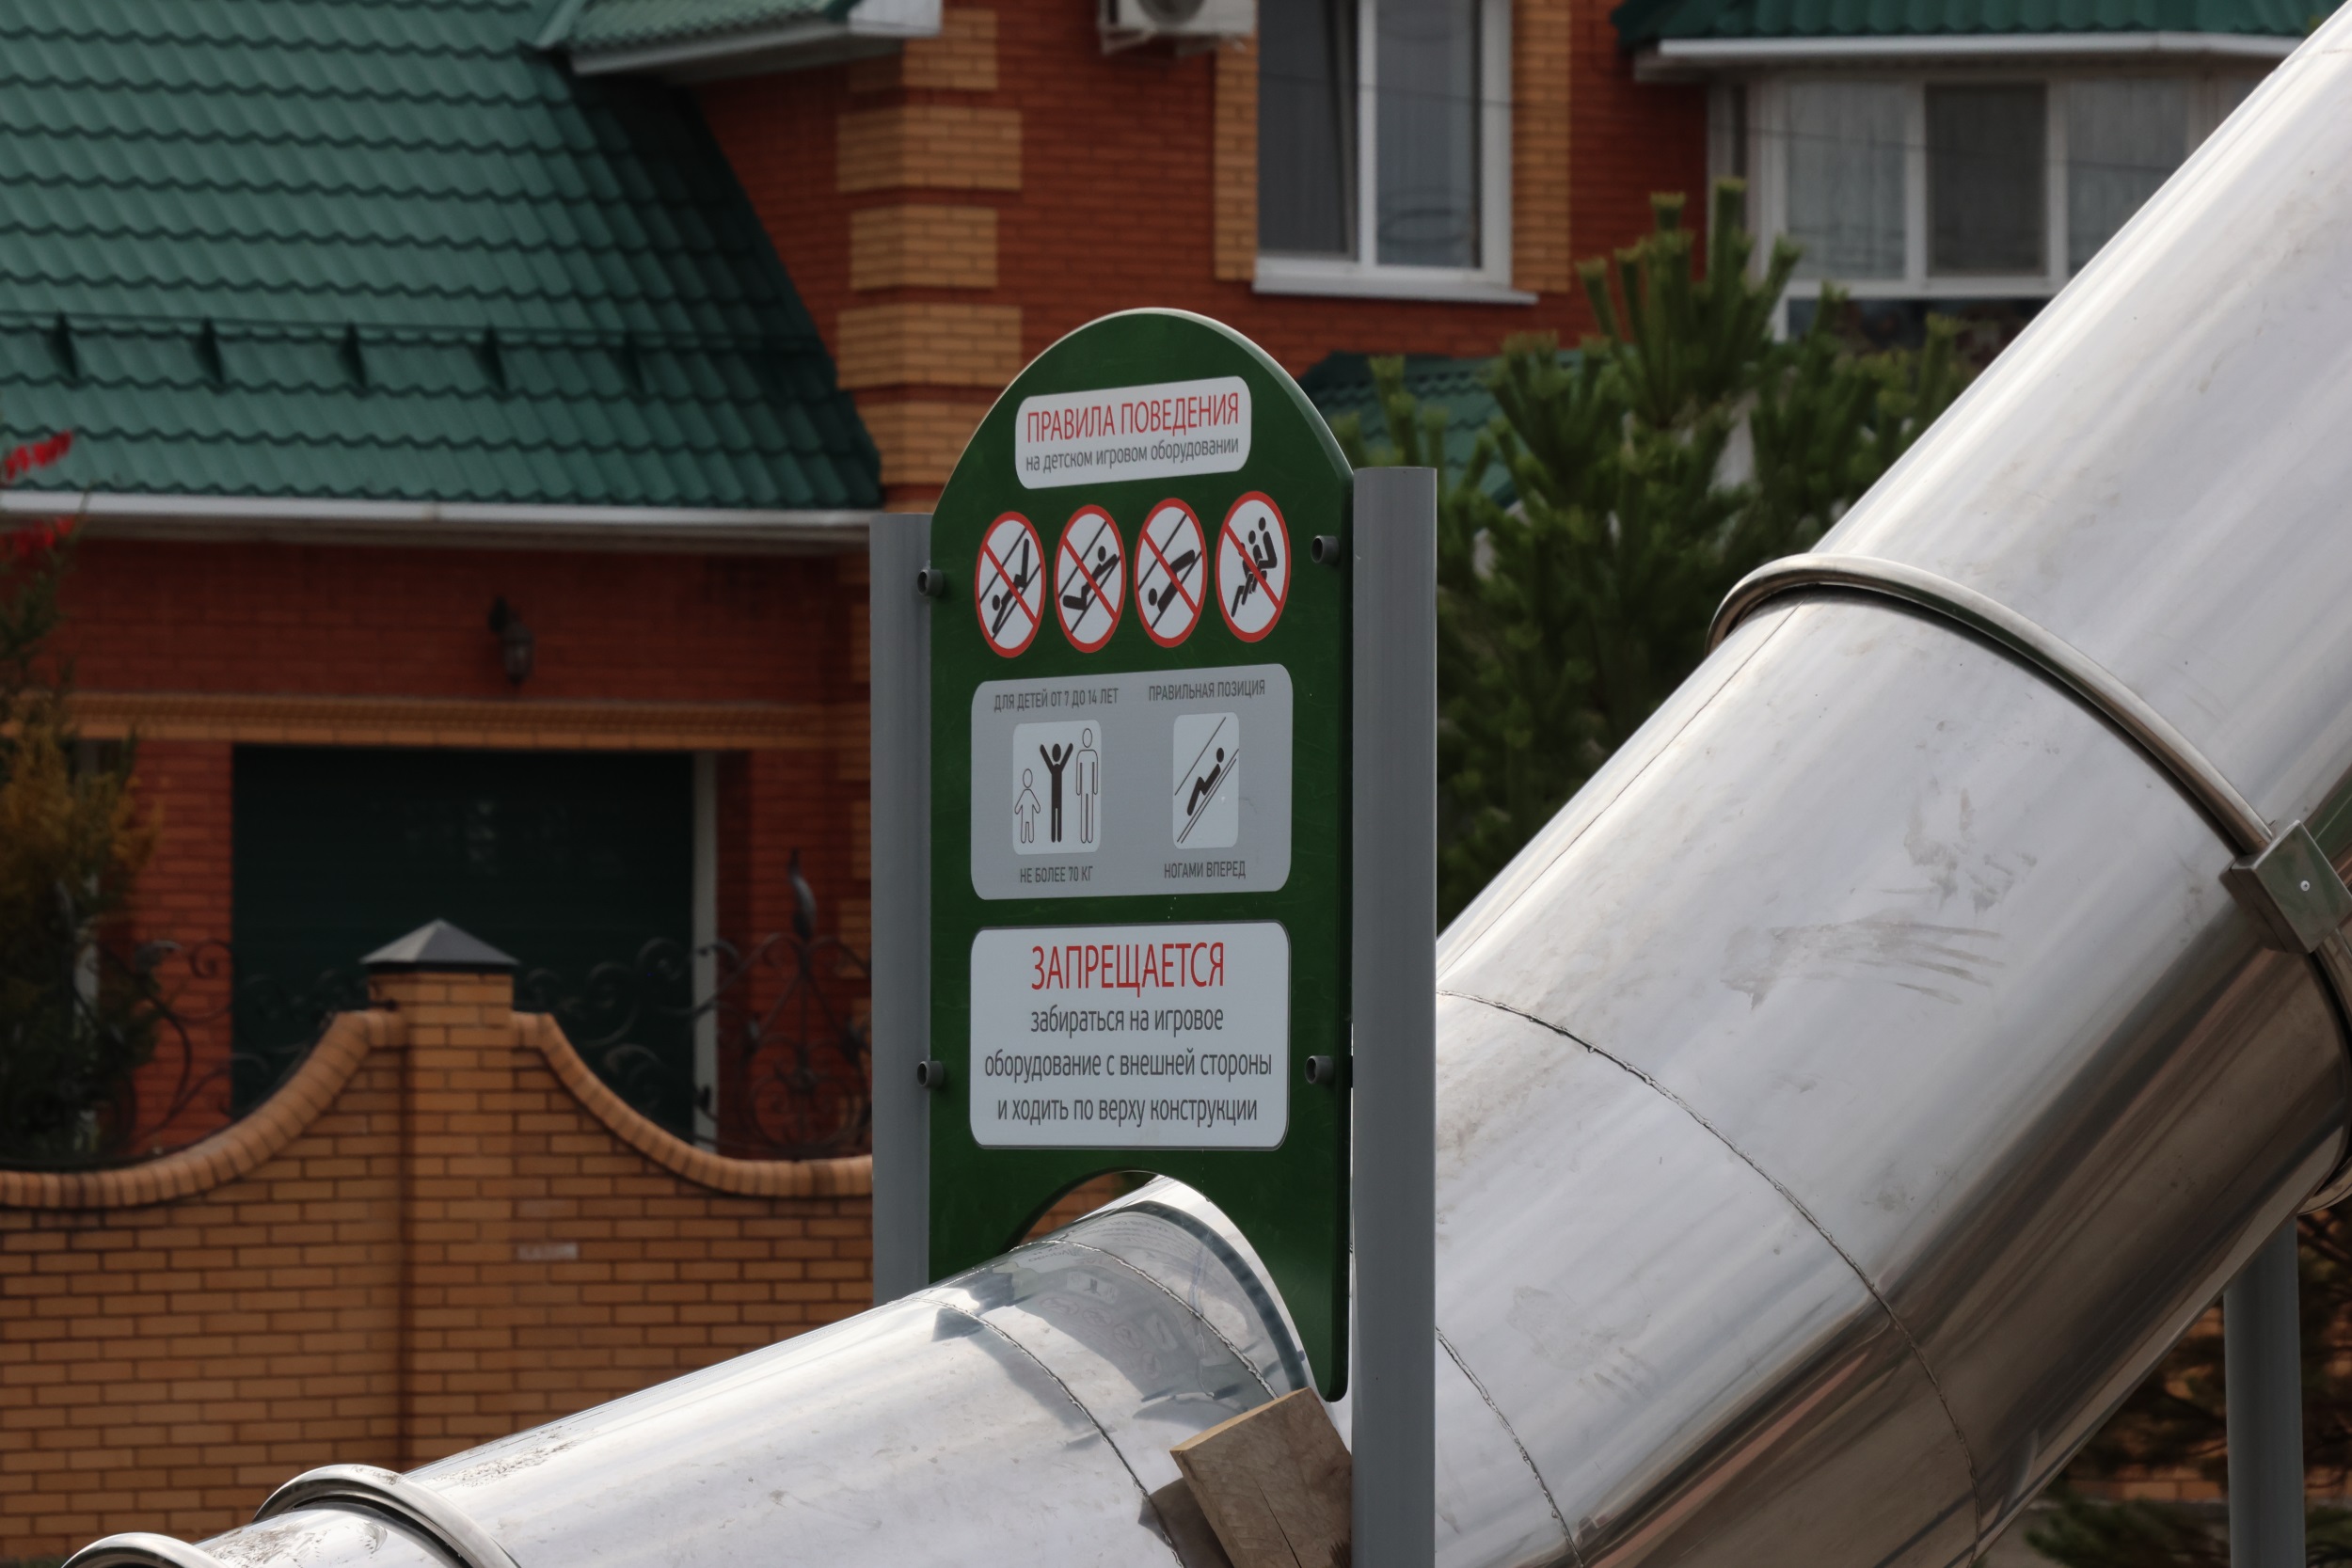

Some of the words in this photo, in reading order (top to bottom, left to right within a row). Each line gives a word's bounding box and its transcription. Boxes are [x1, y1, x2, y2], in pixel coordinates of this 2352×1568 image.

[1027, 405, 1115, 443] ПРАВИЛА
[1120, 392, 1239, 436] ПОВЕДЕНИЯ
[1025, 454, 1041, 471] на
[1042, 451, 1093, 473] детском
[1096, 447, 1148, 468] игровом
[1151, 437, 1239, 465] оборудовании
[993, 694, 1015, 713] ДЛЯ
[1017, 689, 1048, 711] ДЕТЕЙ
[1051, 690, 1063, 707] ОТ
[1064, 689, 1070, 707] 7
[1072, 689, 1086, 708] ДО
[1088, 689, 1098, 705] 14
[1099, 688, 1119, 705] ЛЕТ
[1148, 682, 1215, 702] ПРАВИЛЬНАЯ
[1216, 679, 1265, 699] ПОЗИЦИЯ
[1020, 868, 1033, 883] НЕ
[1035, 866, 1066, 883] БОЛЕЕ
[1068, 866, 1079, 882] 70
[1081, 865, 1093, 881] КГ
[1164, 863, 1203, 879] НОГАМИ
[1206, 861, 1246, 879] ВПЕРЕД
[1031, 942, 1224, 998] ЗАПРЕЩАЕТСЯ
[1030, 1004, 1124, 1038] забираться
[1130, 1008, 1149, 1031] на
[1154, 1007, 1224, 1037] игровое
[984, 1049, 1102, 1084] оборудование
[1106, 1053, 1115, 1076] с
[1120, 1048, 1195, 1076] внешней
[1200, 1053, 1272, 1083] стороны
[997, 1100, 1008, 1120] и
[1011, 1099, 1069, 1126] ходить
[1073, 1099, 1093, 1120] по
[1099, 1099, 1146, 1127] верху
[1151, 1098, 1257, 1127] конструкции
